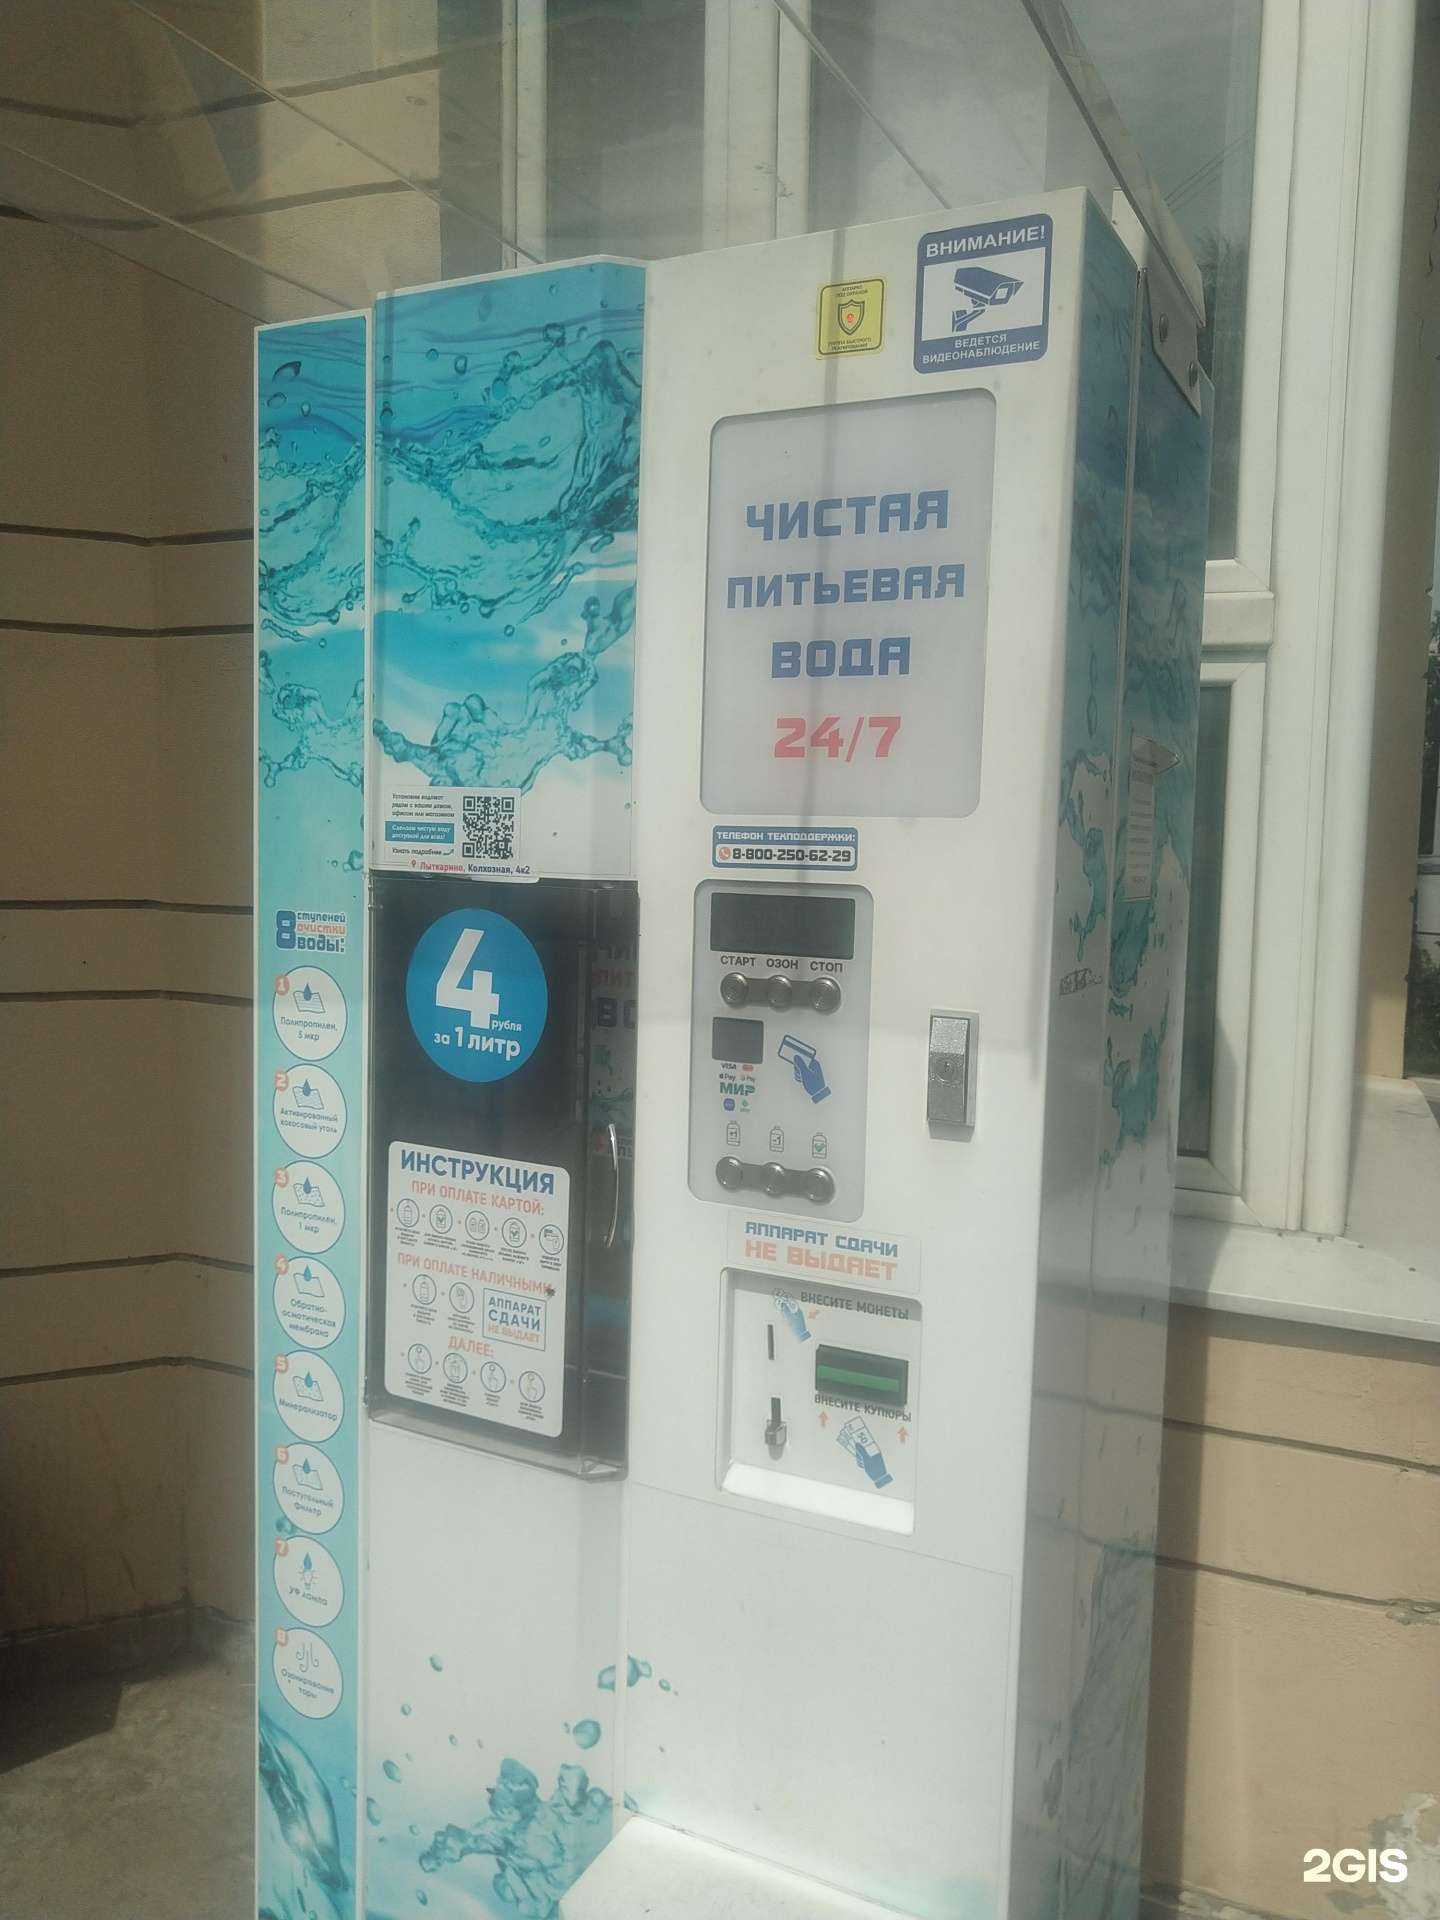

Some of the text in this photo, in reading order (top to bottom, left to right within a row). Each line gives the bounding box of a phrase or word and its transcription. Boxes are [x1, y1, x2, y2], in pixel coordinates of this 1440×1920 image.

[926, 225, 1045, 258] ВНИМАНИЕ!
[922, 340, 1040, 364] ВИДЕОНАБЛЮДЕНИЕ
[954, 334, 1007, 349] ВЕДЕТСЯ
[746, 490, 949, 541] ЧИСТАЯ
[727, 563, 965, 609] ПИТЬЕВАЯ
[771, 636, 911, 679] ВОДА
[774, 716, 901, 762] 24/7
[717, 831, 763, 840] ТЕЛЕФОН
[468, 863, 513, 875] Колхозная,
[515, 865, 530, 875] 4к2
[732, 848, 851, 862] 8-800-250-62-29
[276, 910, 346, 949] 8 ступеней
[297, 934, 345, 952] воды:
[720, 955, 843, 973] СТАРТ ОЗОН СТОП
[435, 928, 522, 1032] 4 рубля
[434, 1026, 521, 1061] за 1 литр
[720, 1082, 756, 1096] МИР
[401, 1149, 555, 1195] ИНСТРУКЦИЯ
[412, 1180, 545, 1216] ПРИ ОПЛАТЕ КАРТОЙ:
[746, 1221, 899, 1258] АППАРАТ СДАЧИ
[398, 1253, 420, 1267] ПРИ
[423, 1257, 469, 1278] ОПЛАТЕ
[745, 1240, 898, 1281] НЕ ВЫДАЕТ
[488, 1296, 542, 1317] АППАРАТ
[488, 1309, 541, 1331] СДАЧИ
[800, 1291, 909, 1321] ВНЕСИТЕ МОНЕТЫ
[814, 1394, 913, 1422] ВНЕСИТЕ КУПЮРЫ
